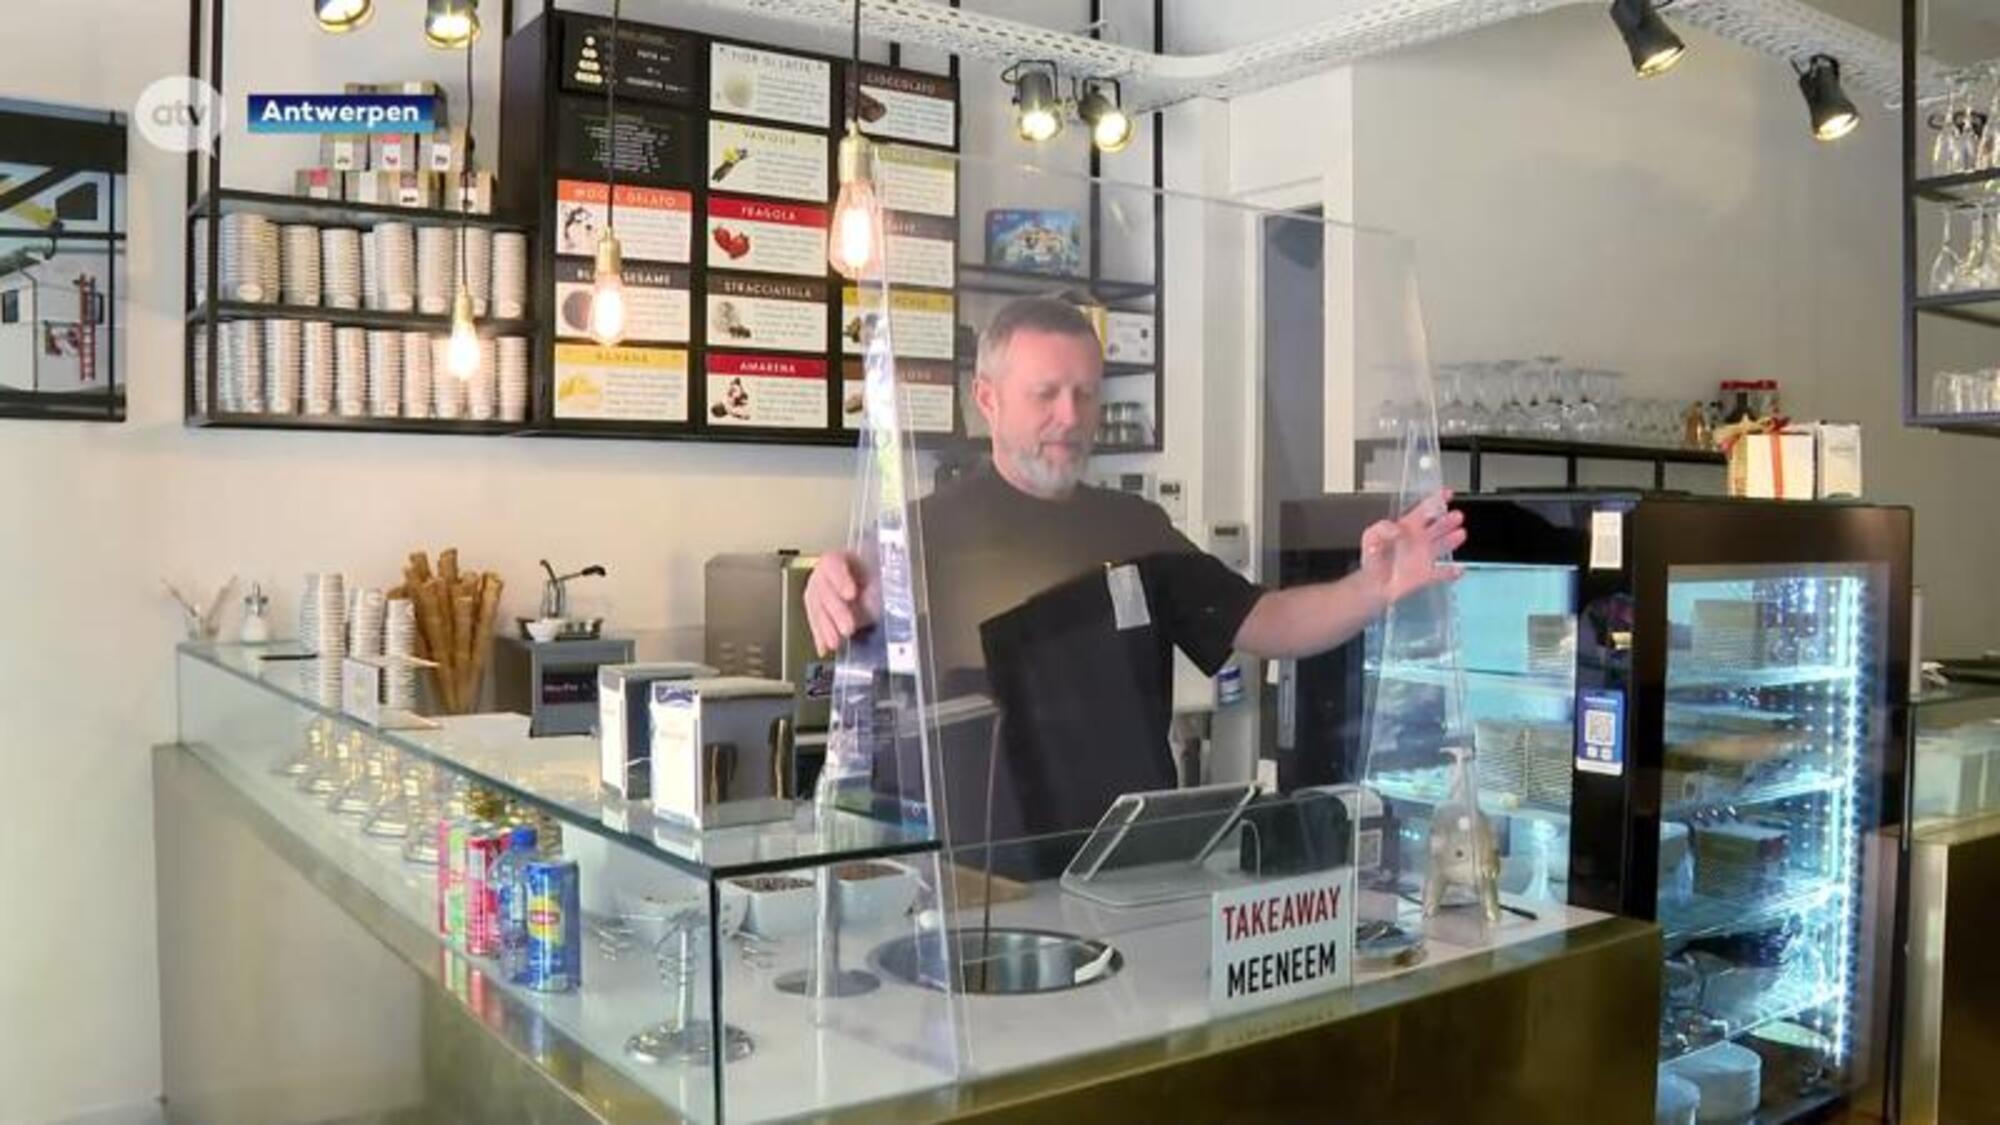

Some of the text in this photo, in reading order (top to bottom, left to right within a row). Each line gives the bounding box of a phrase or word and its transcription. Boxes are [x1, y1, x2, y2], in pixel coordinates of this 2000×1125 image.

[741, 206, 797, 221] FRAGOLA
[622, 271, 671, 286] SESAME
[724, 281, 812, 298] STRACCIATELLA
[740, 361, 797, 374] AMARENA
[1222, 885, 1341, 942] TAKEAWAY
[1227, 940, 1336, 998] MEENEEM
